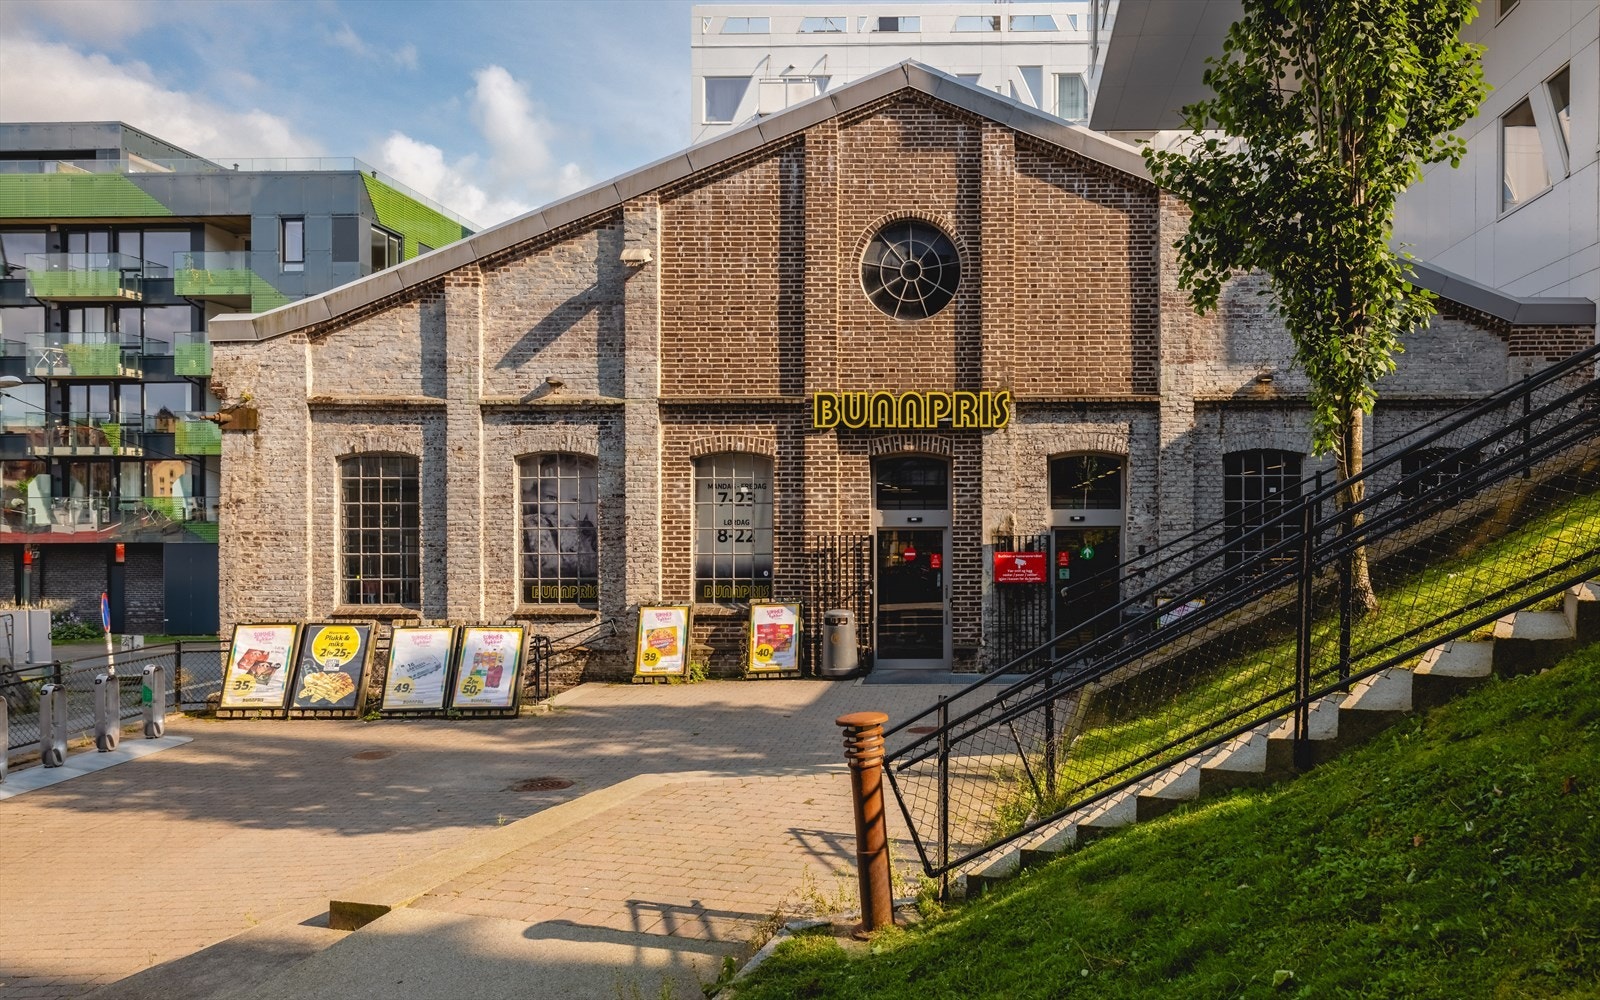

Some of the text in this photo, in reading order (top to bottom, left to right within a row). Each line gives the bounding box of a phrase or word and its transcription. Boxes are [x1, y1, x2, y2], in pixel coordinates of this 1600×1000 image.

[814, 391, 1010, 428] BUNNPRIS
[718, 529, 756, 543] 8-22
[532, 586, 598, 598] BUNNPRIS
[704, 585, 770, 598] BUNNPRIS
[319, 648, 327, 657] 2
